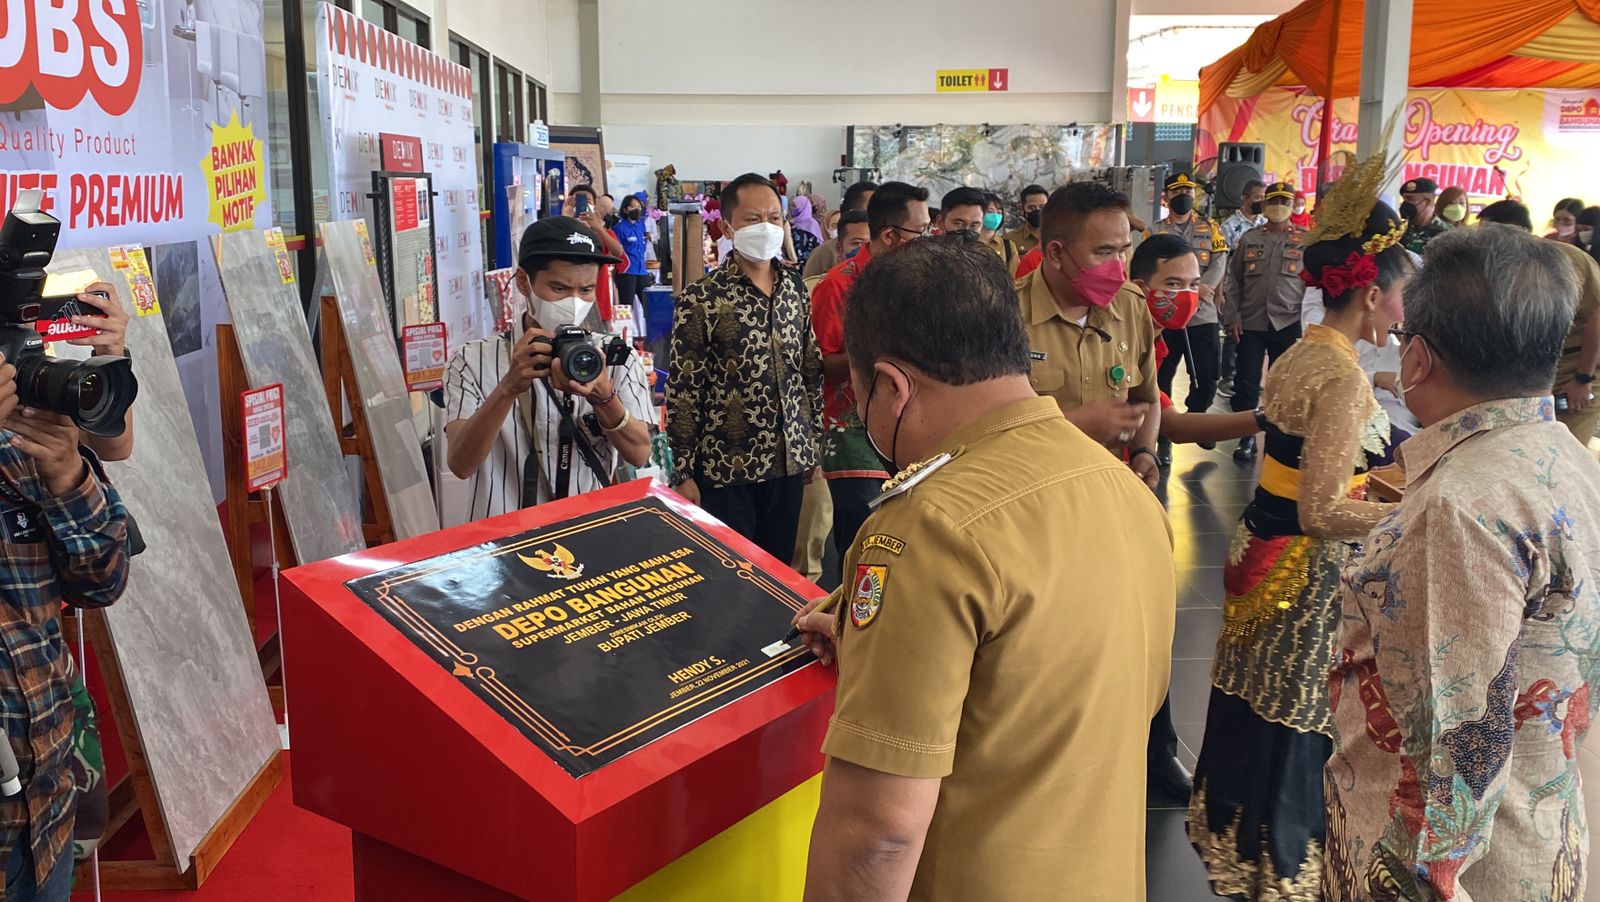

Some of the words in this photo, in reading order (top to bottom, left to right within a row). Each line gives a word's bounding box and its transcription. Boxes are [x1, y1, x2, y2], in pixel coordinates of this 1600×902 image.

[939, 75, 973, 87] TOILET
[0, 122, 65, 159] Quality
[74, 127, 137, 155] Product
[1403, 97, 1523, 165] Opening
[211, 138, 255, 171] BANYAK
[69, 172, 184, 230] PREMIUM
[215, 167, 257, 201] PILIHAN
[222, 195, 255, 229] MOTIF
[560, 444, 569, 470] Canon
[453, 607, 514, 633] DENGAN
[512, 589, 567, 613] RAHMAT
[565, 574, 610, 594] TUHAN
[606, 564, 641, 580] YANG
[638, 554, 674, 570] MAHA
[669, 546, 695, 560] ESA
[492, 605, 568, 640] DEPO
[565, 561, 696, 614] BANGUNAN
[511, 609, 605, 649] SUPERMARKET
[604, 595, 647, 614] BAHAN
[645, 574, 706, 600] BANGUNAN
[563, 619, 616, 644] JEMBER
[620, 605, 655, 622] JAWA
[649, 592, 688, 610] TIMUR
[597, 629, 646, 653] BUPATI
[643, 611, 693, 635] JEMBER
[667, 659, 712, 684] HENDY
[709, 655, 726, 666] S.
[703, 664, 737, 684] NOVEMBER
[734, 658, 751, 669] 2021
